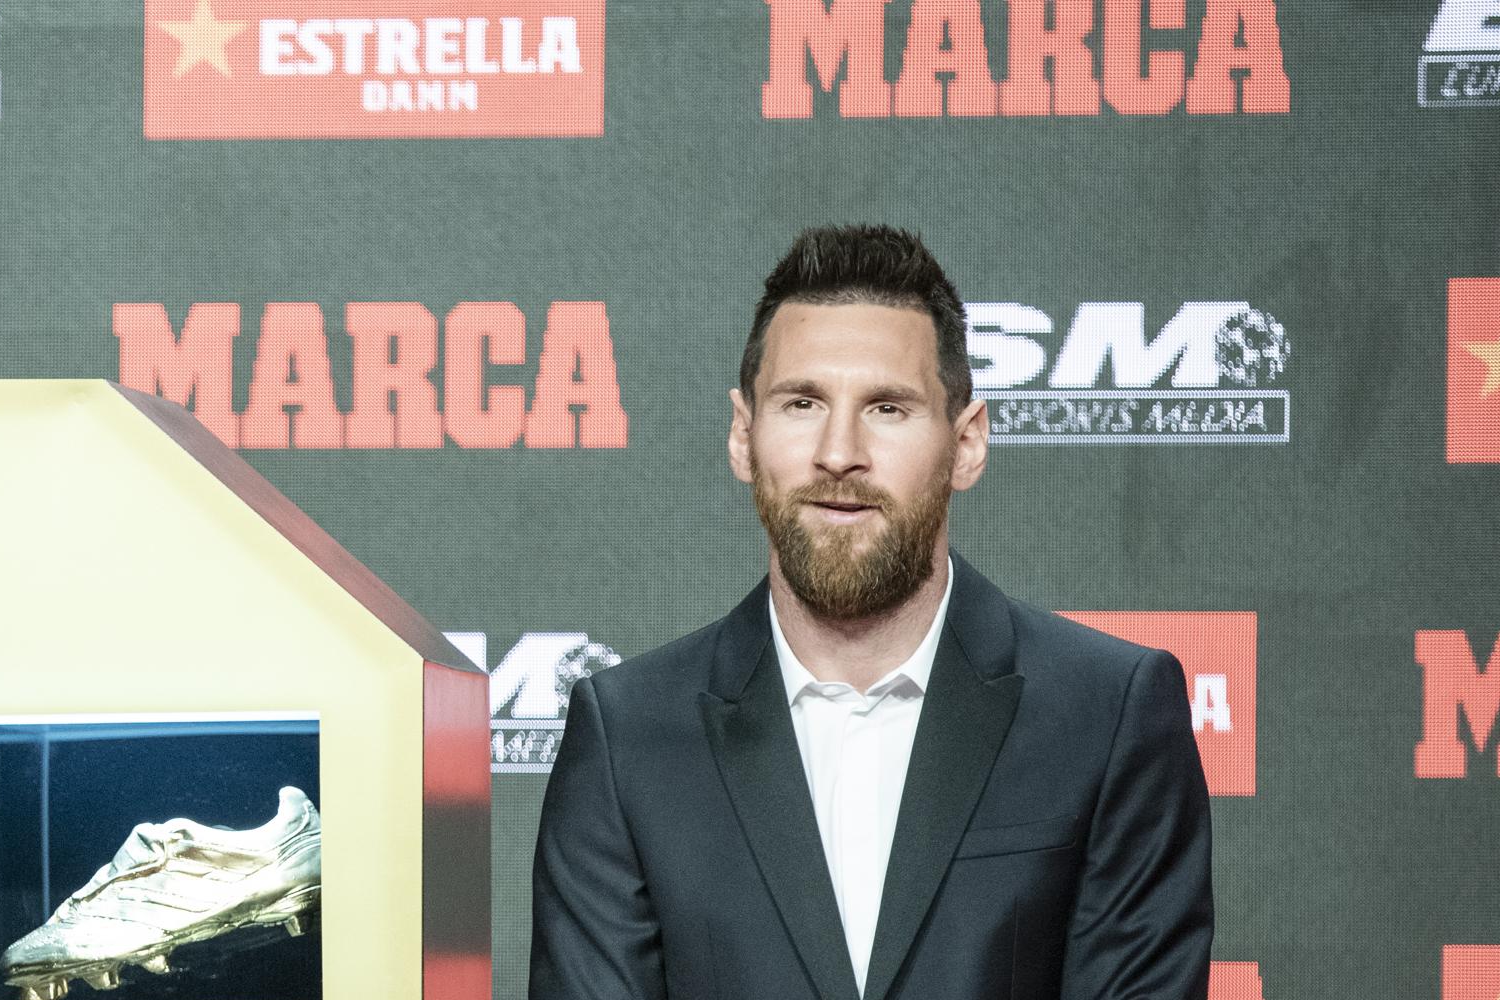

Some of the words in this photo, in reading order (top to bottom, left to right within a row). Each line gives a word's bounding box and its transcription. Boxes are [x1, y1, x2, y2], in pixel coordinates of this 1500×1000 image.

[258, 17, 583, 76] ESTRELLA
[761, 0, 1291, 118] MARCA
[361, 80, 478, 112] DAMM
[112, 301, 628, 449] MARCA
